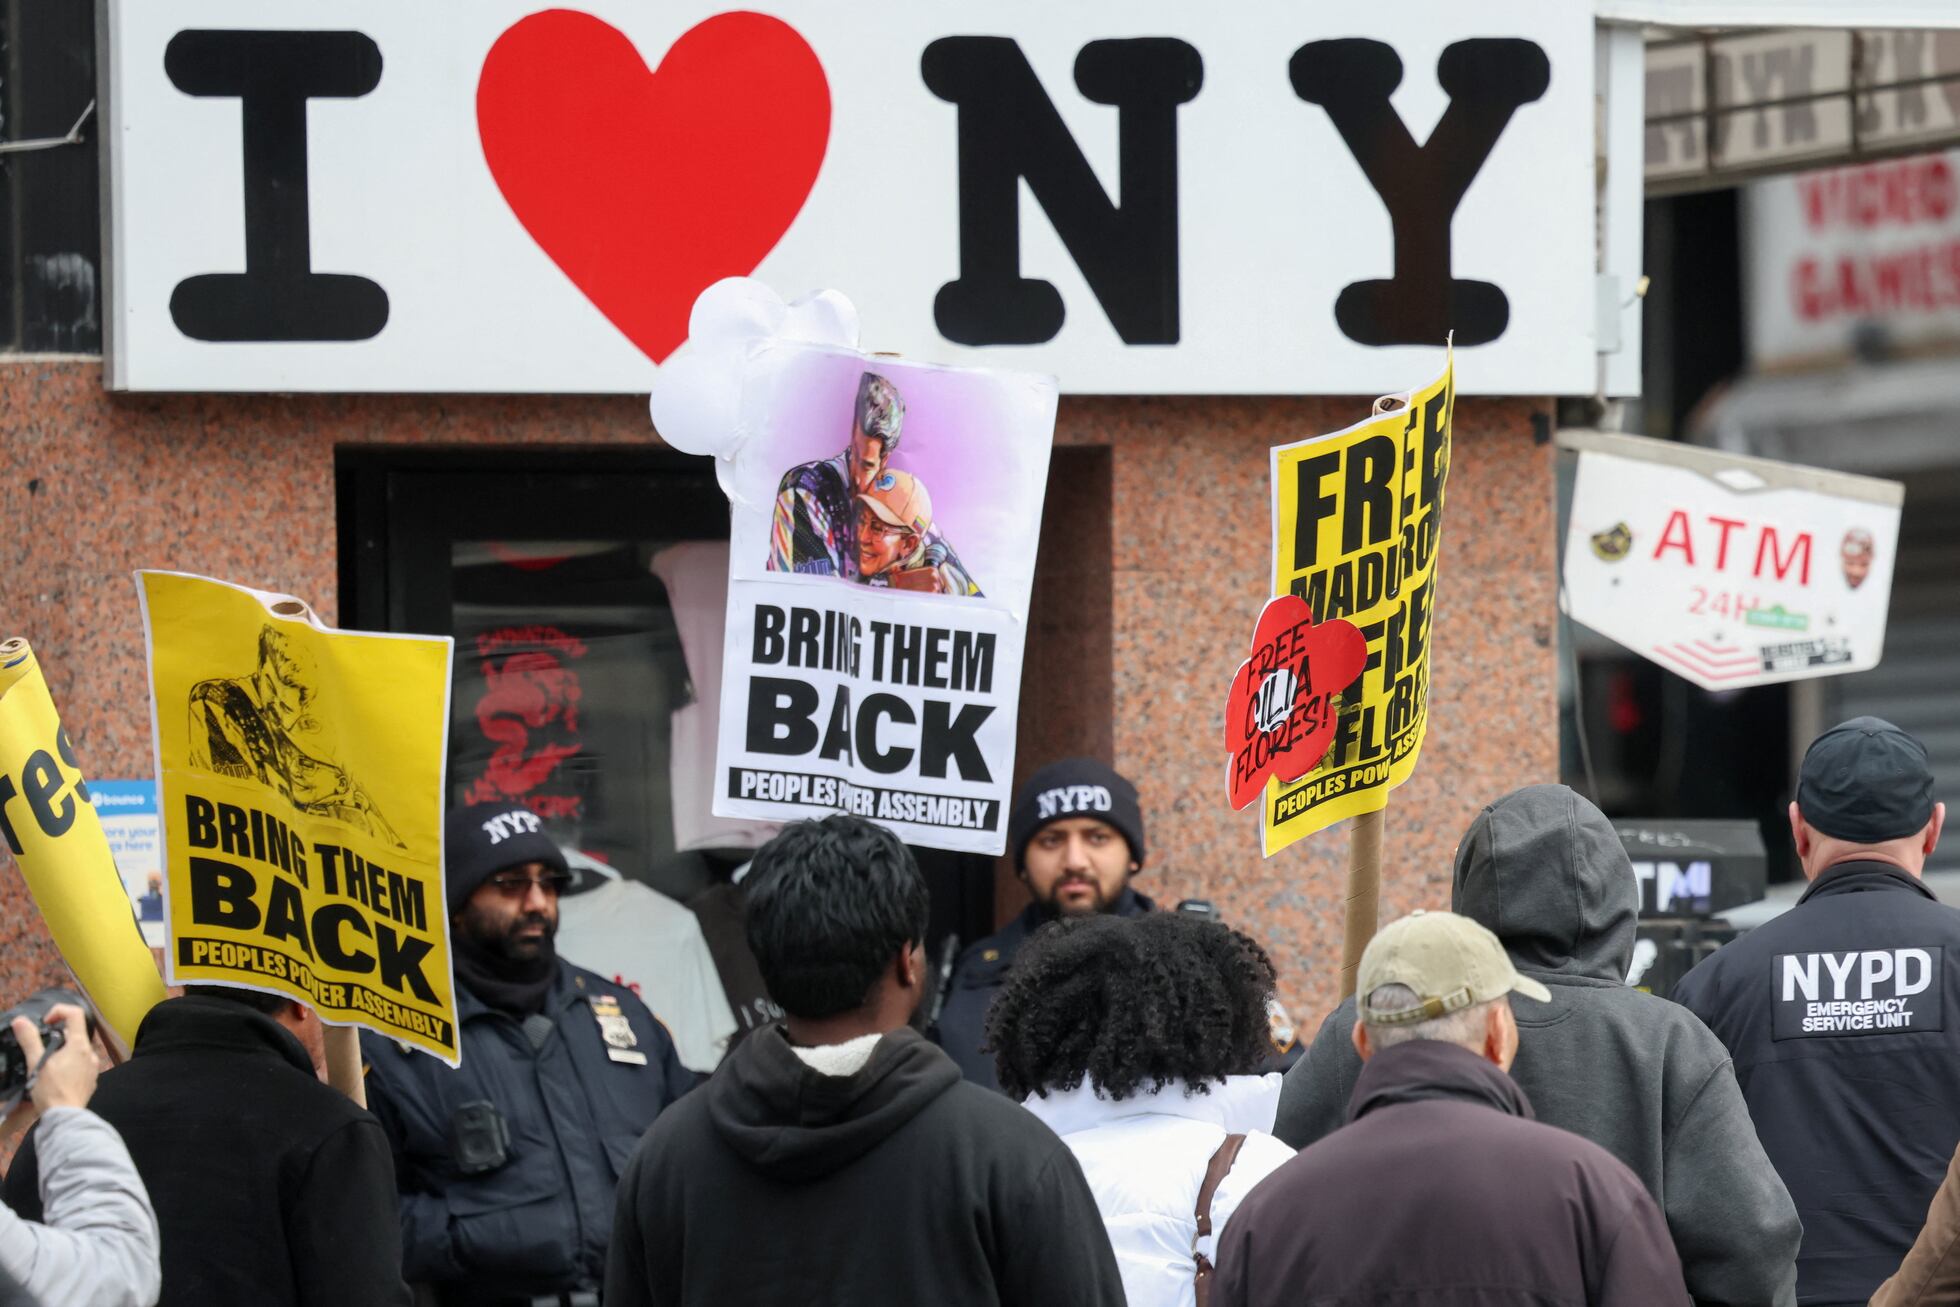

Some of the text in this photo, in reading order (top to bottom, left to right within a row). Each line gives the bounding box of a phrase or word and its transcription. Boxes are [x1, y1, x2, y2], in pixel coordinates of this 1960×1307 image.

[164, 29, 389, 342] I
[921, 35, 1550, 347] NY
[1294, 384, 1446, 571] FREE
[1290, 510, 1434, 625] MADURO
[1653, 511, 1812, 586] ATM
[752, 604, 997, 693] BRING THEM
[1246, 618, 1310, 696] FREE
[745, 675, 997, 783] BACK
[1244, 655, 1312, 742] CILIA
[1235, 691, 1331, 795] FLORES!
[482, 810, 541, 844] NYP
[741, 770, 836, 806] PEOPLES
[877, 790, 989, 828] ASSEMBLY
[1037, 785, 1112, 819] NYPD
[1277, 758, 1389, 820] PEOPLES POW
[186, 794, 427, 932] BRING THEM
[1632, 861, 1711, 912] TM
[189, 856, 443, 1008] BACK
[192, 940, 286, 977] PEOPLES
[352, 986, 444, 1041] ASSEMBLY
[1782, 948, 1932, 1001] NYPD
[1806, 998, 1908, 1017] EMERGENCY
[1802, 1011, 1913, 1032] SERVICE UNIT
